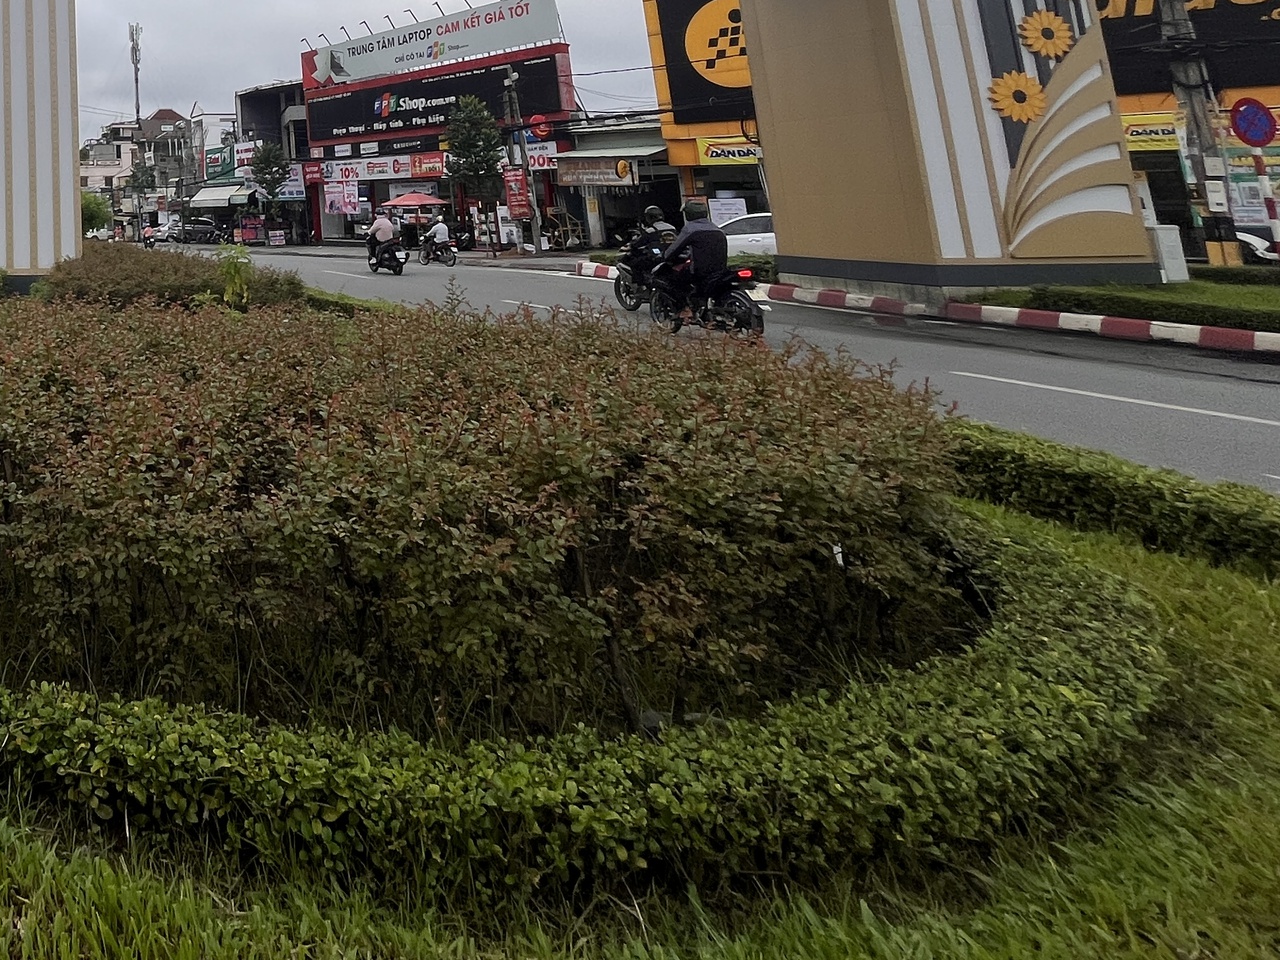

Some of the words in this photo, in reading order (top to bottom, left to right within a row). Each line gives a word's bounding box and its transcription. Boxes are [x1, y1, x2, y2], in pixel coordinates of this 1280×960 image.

[347, 42, 375, 58] TRUNG
[376, 36, 396, 54] TÂM
[397, 28, 432, 47] LAPTOP
[436, 19, 460, 37] CAM
[463, 11, 481, 29] KẾT
[484, 5, 506, 26] GIÁ
[507, 0, 530, 19] TỐT
[339, 167, 360, 179] 10%
